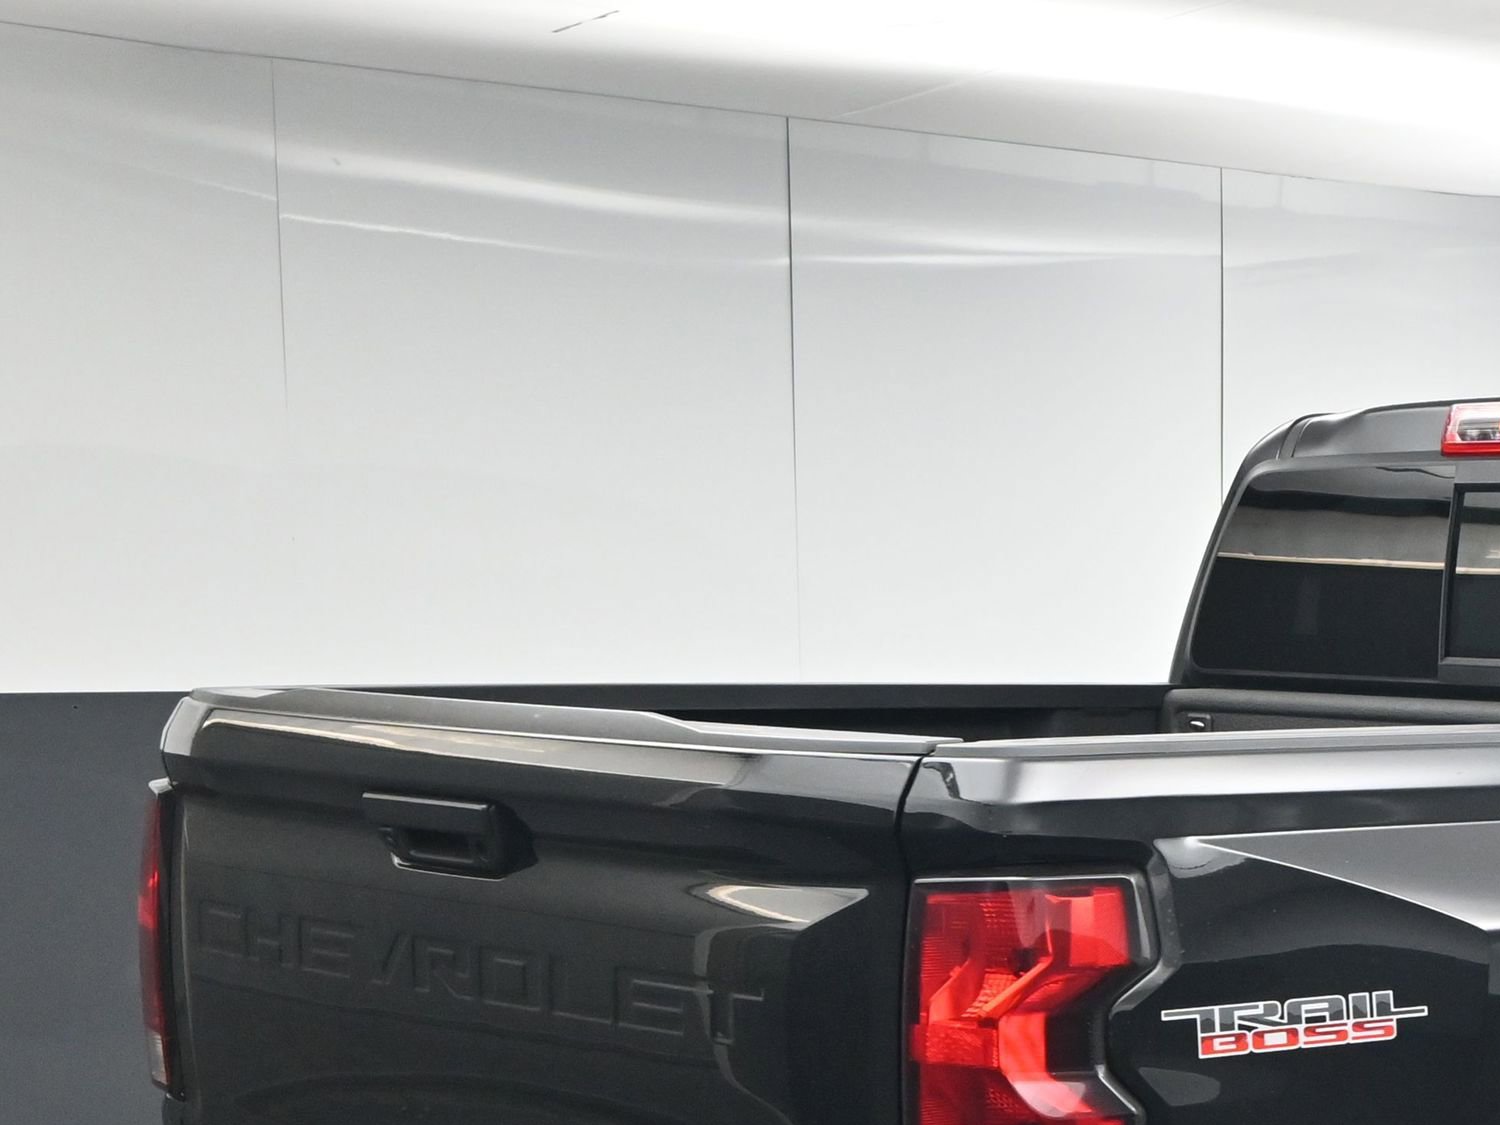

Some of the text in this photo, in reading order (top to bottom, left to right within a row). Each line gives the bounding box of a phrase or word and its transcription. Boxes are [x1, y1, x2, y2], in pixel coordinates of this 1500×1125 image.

[196, 900, 766, 1046] CHEVROLET
[1160, 990, 1428, 1034] TRAIL
[1198, 1017, 1397, 1059] BOSS
